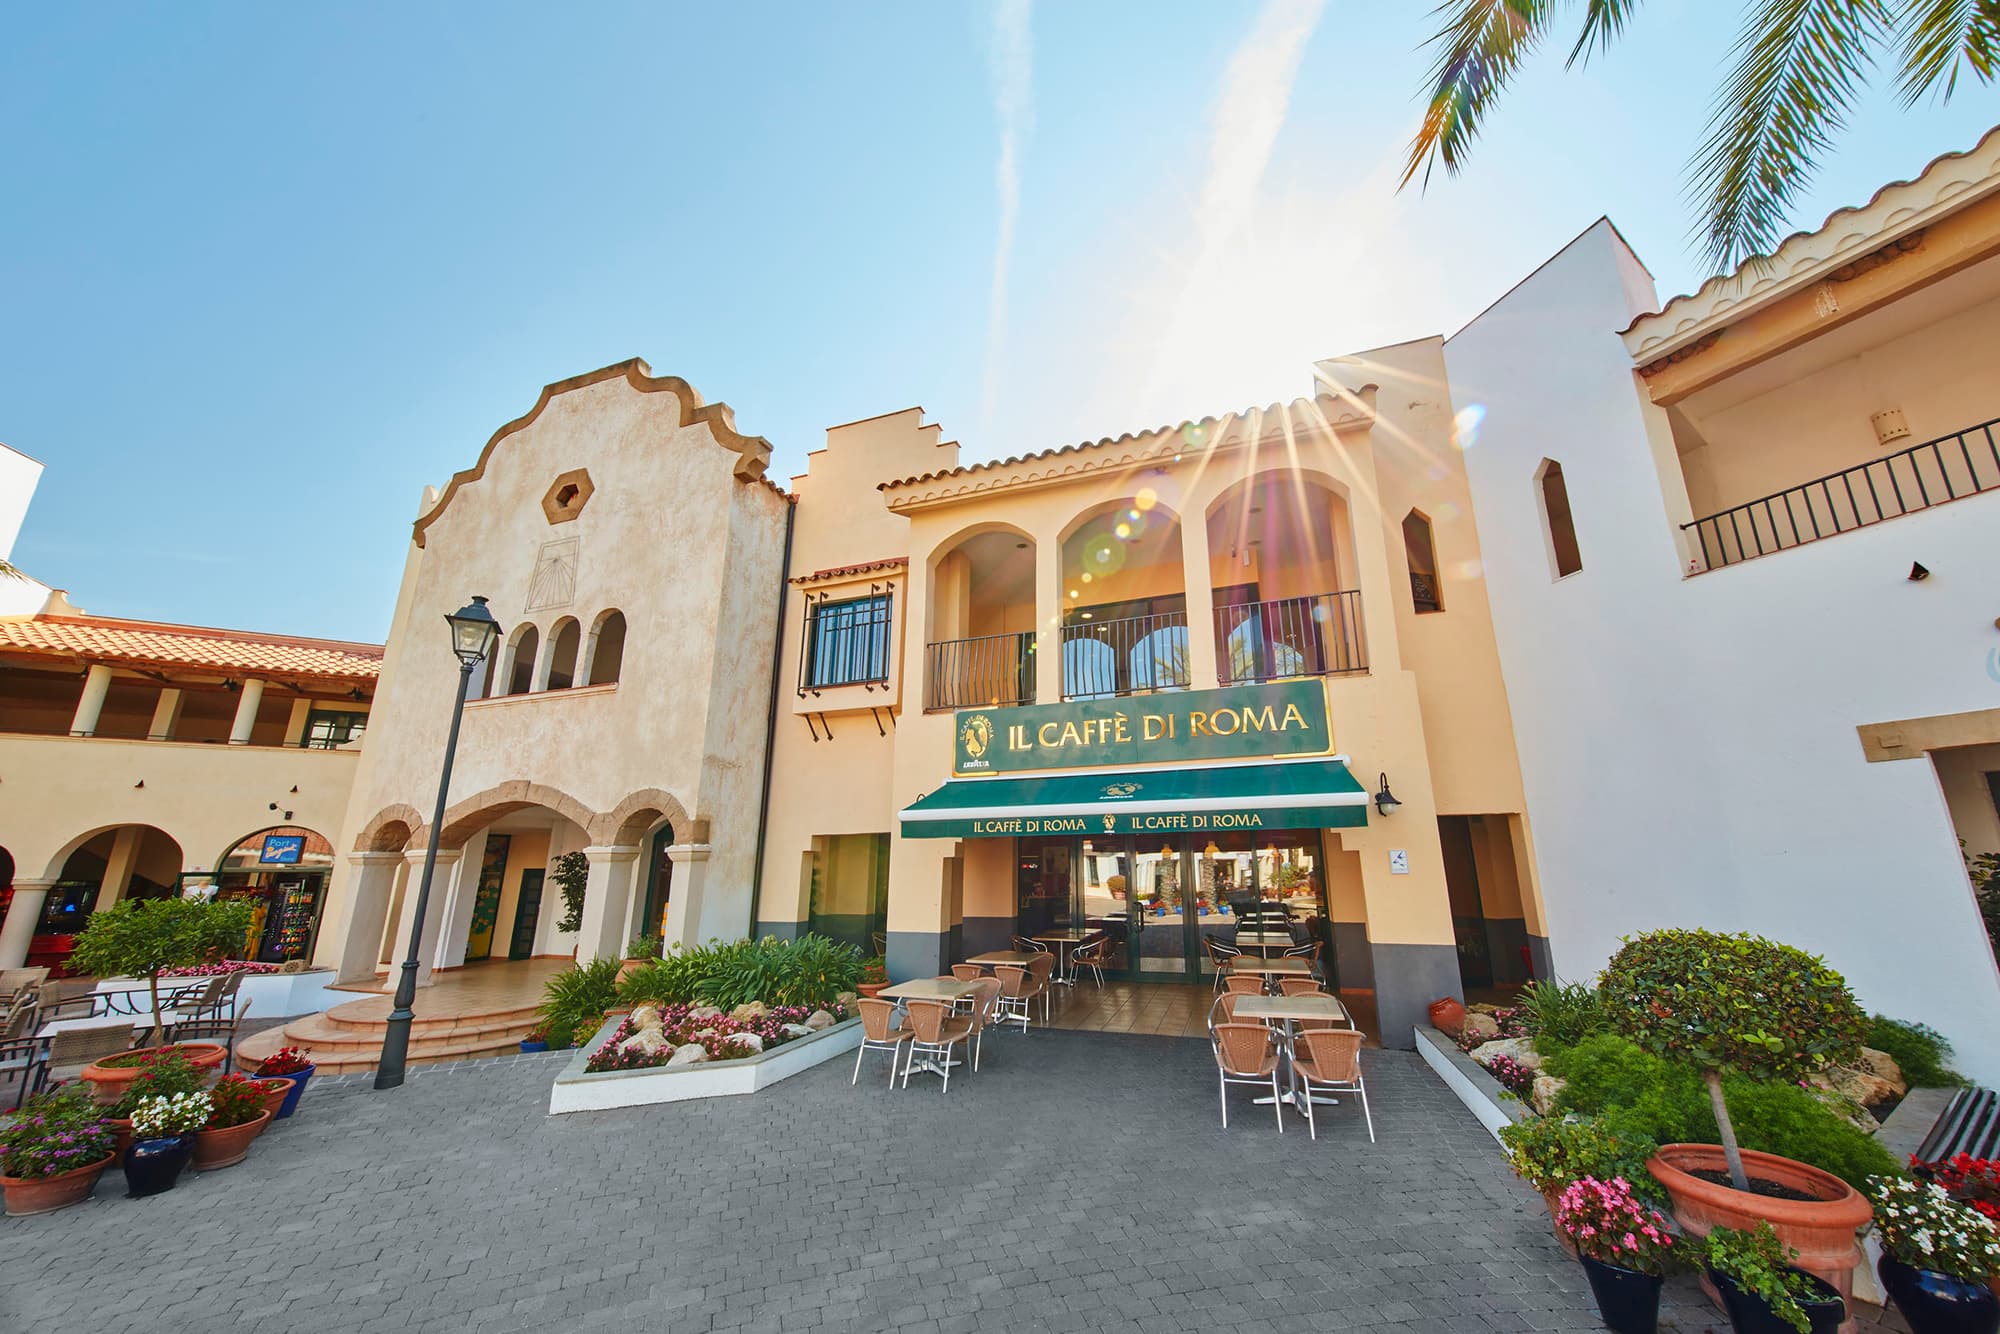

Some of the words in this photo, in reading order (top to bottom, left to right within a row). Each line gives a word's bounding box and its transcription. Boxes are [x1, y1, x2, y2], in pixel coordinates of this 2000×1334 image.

[1008, 725, 1032, 750] IL
[1038, 711, 1132, 747] CAFFÈ
[1143, 713, 1174, 741] DI
[1190, 703, 1309, 736] ROMA
[974, 821, 984, 833] IL
[986, 818, 1022, 833] CAFFÈ
[1027, 820, 1039, 832] DI
[1044, 818, 1086, 831] ROMA
[1132, 816, 1144, 829] IL
[1145, 813, 1188, 829] CAFFÈ
[1192, 815, 1207, 827] DI
[1212, 813, 1262, 827] ROMA
[270, 839, 291, 847] Port
